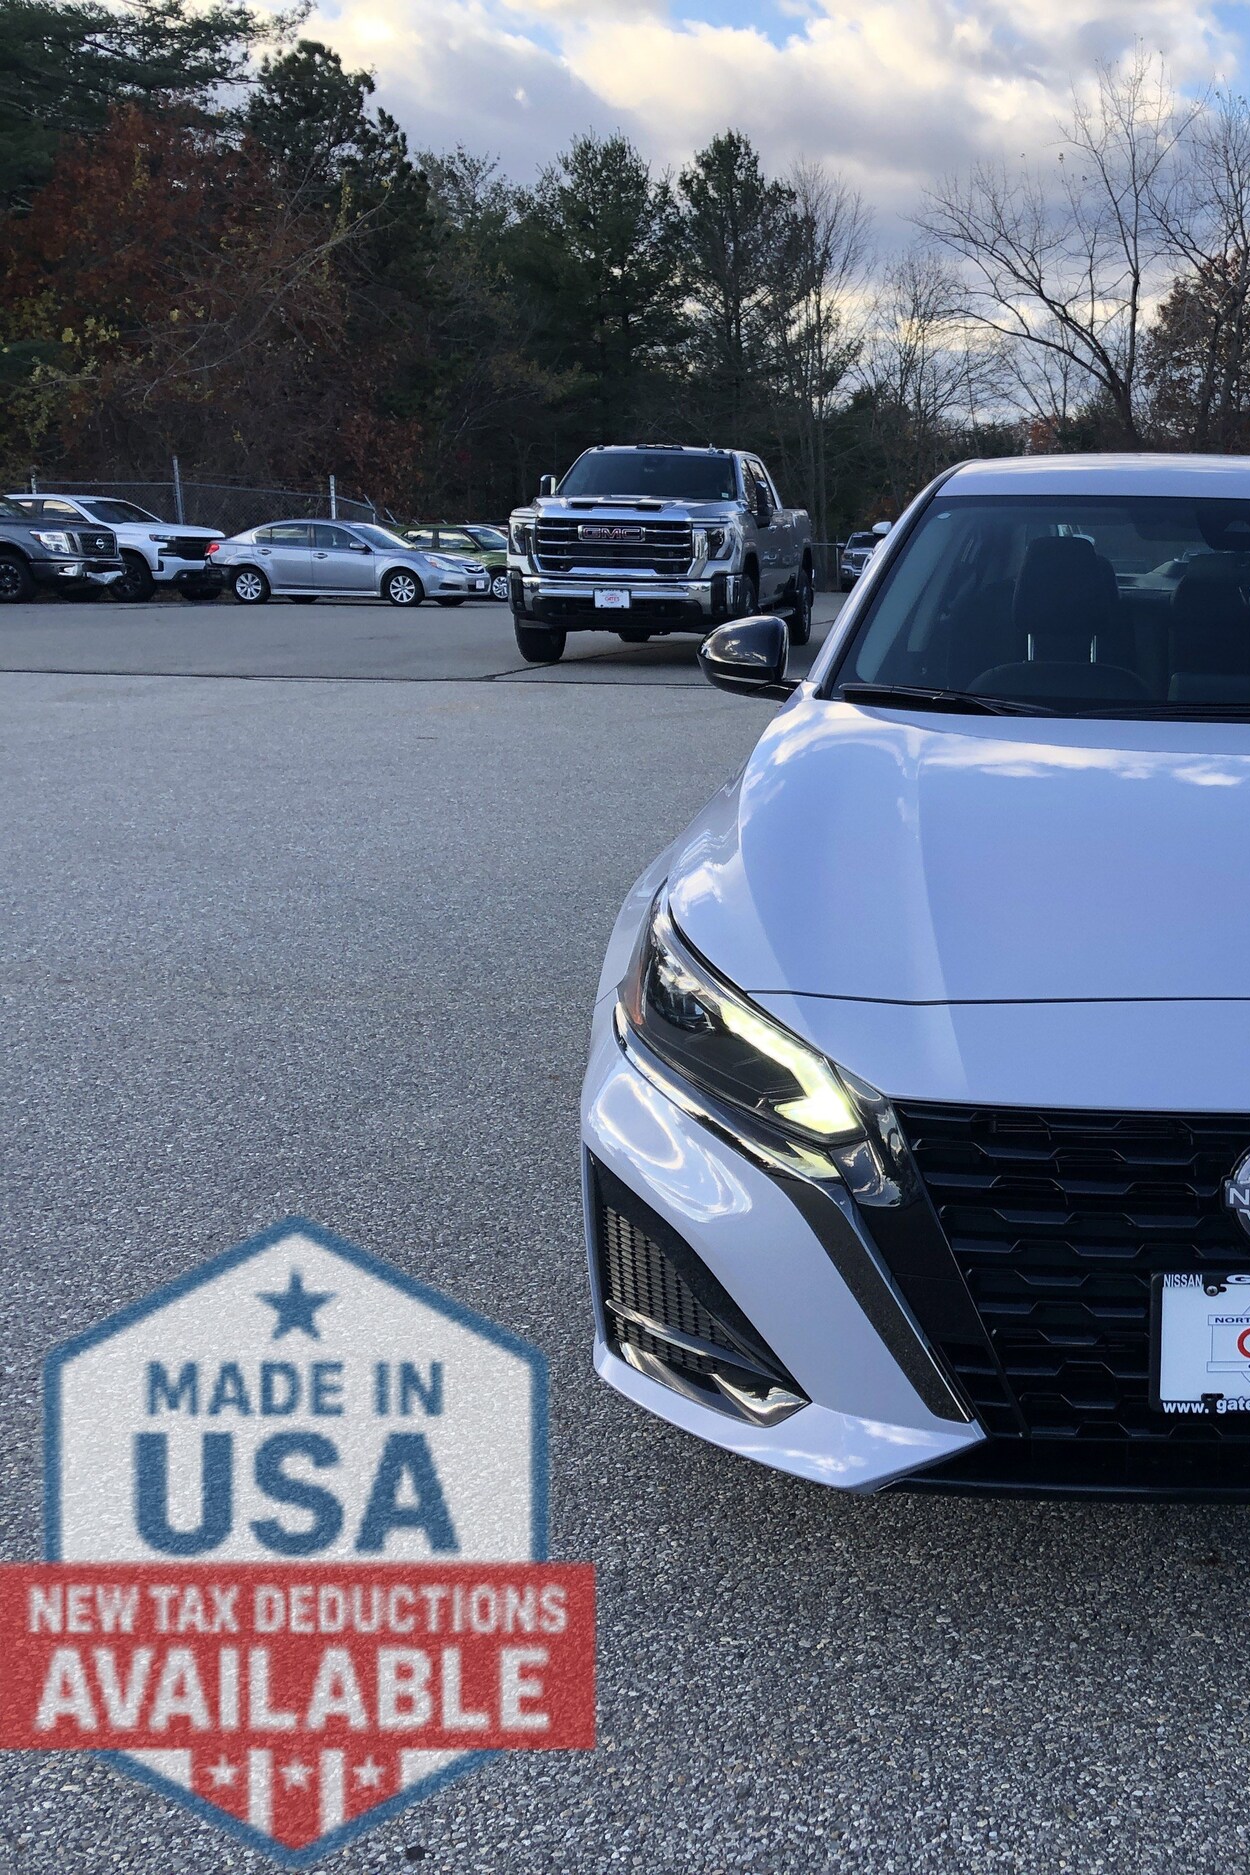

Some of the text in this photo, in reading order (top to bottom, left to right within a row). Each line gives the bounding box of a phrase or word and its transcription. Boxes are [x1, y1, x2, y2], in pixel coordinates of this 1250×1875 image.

[583, 527, 641, 539] GMC
[1163, 1274, 1203, 1288] NISSAN
[1162, 1402, 1210, 1414] www.
